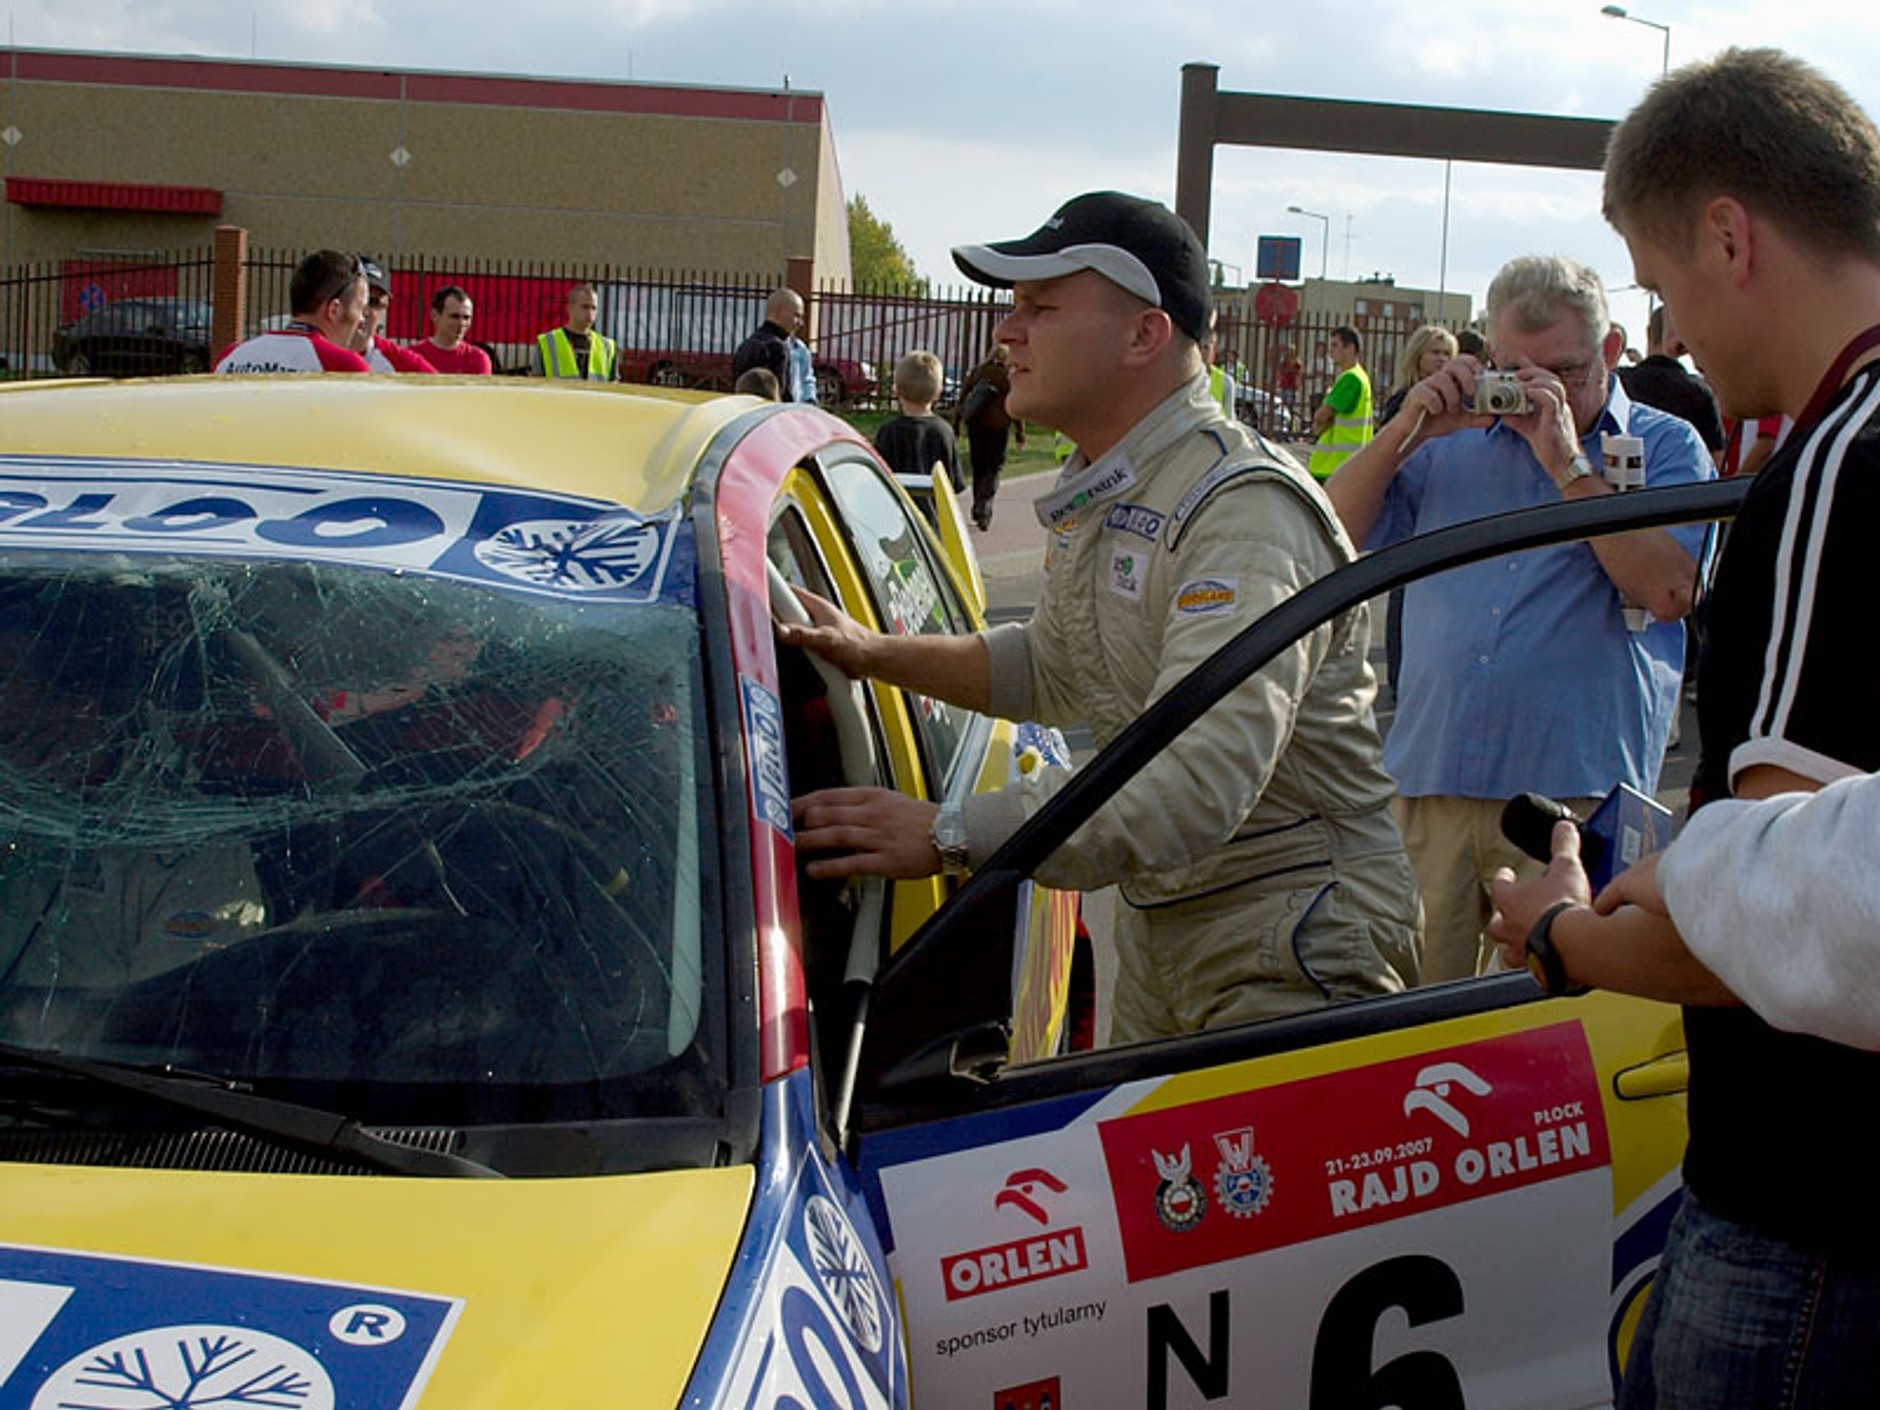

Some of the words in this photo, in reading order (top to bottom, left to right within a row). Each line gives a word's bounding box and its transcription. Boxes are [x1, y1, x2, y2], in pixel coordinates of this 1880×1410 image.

[1326, 1138, 1432, 1176] 21-23.09.2007
[1328, 1160, 1440, 1217] RAJD
[1455, 1121, 1590, 1184] ORLEN
[951, 1234, 1079, 1292] ORLEN
[937, 1322, 1016, 1356] sponsor
[1024, 1301, 1106, 1337] tytularny
[1147, 1290, 1230, 1410] N
[1309, 1254, 1466, 1410] 6
